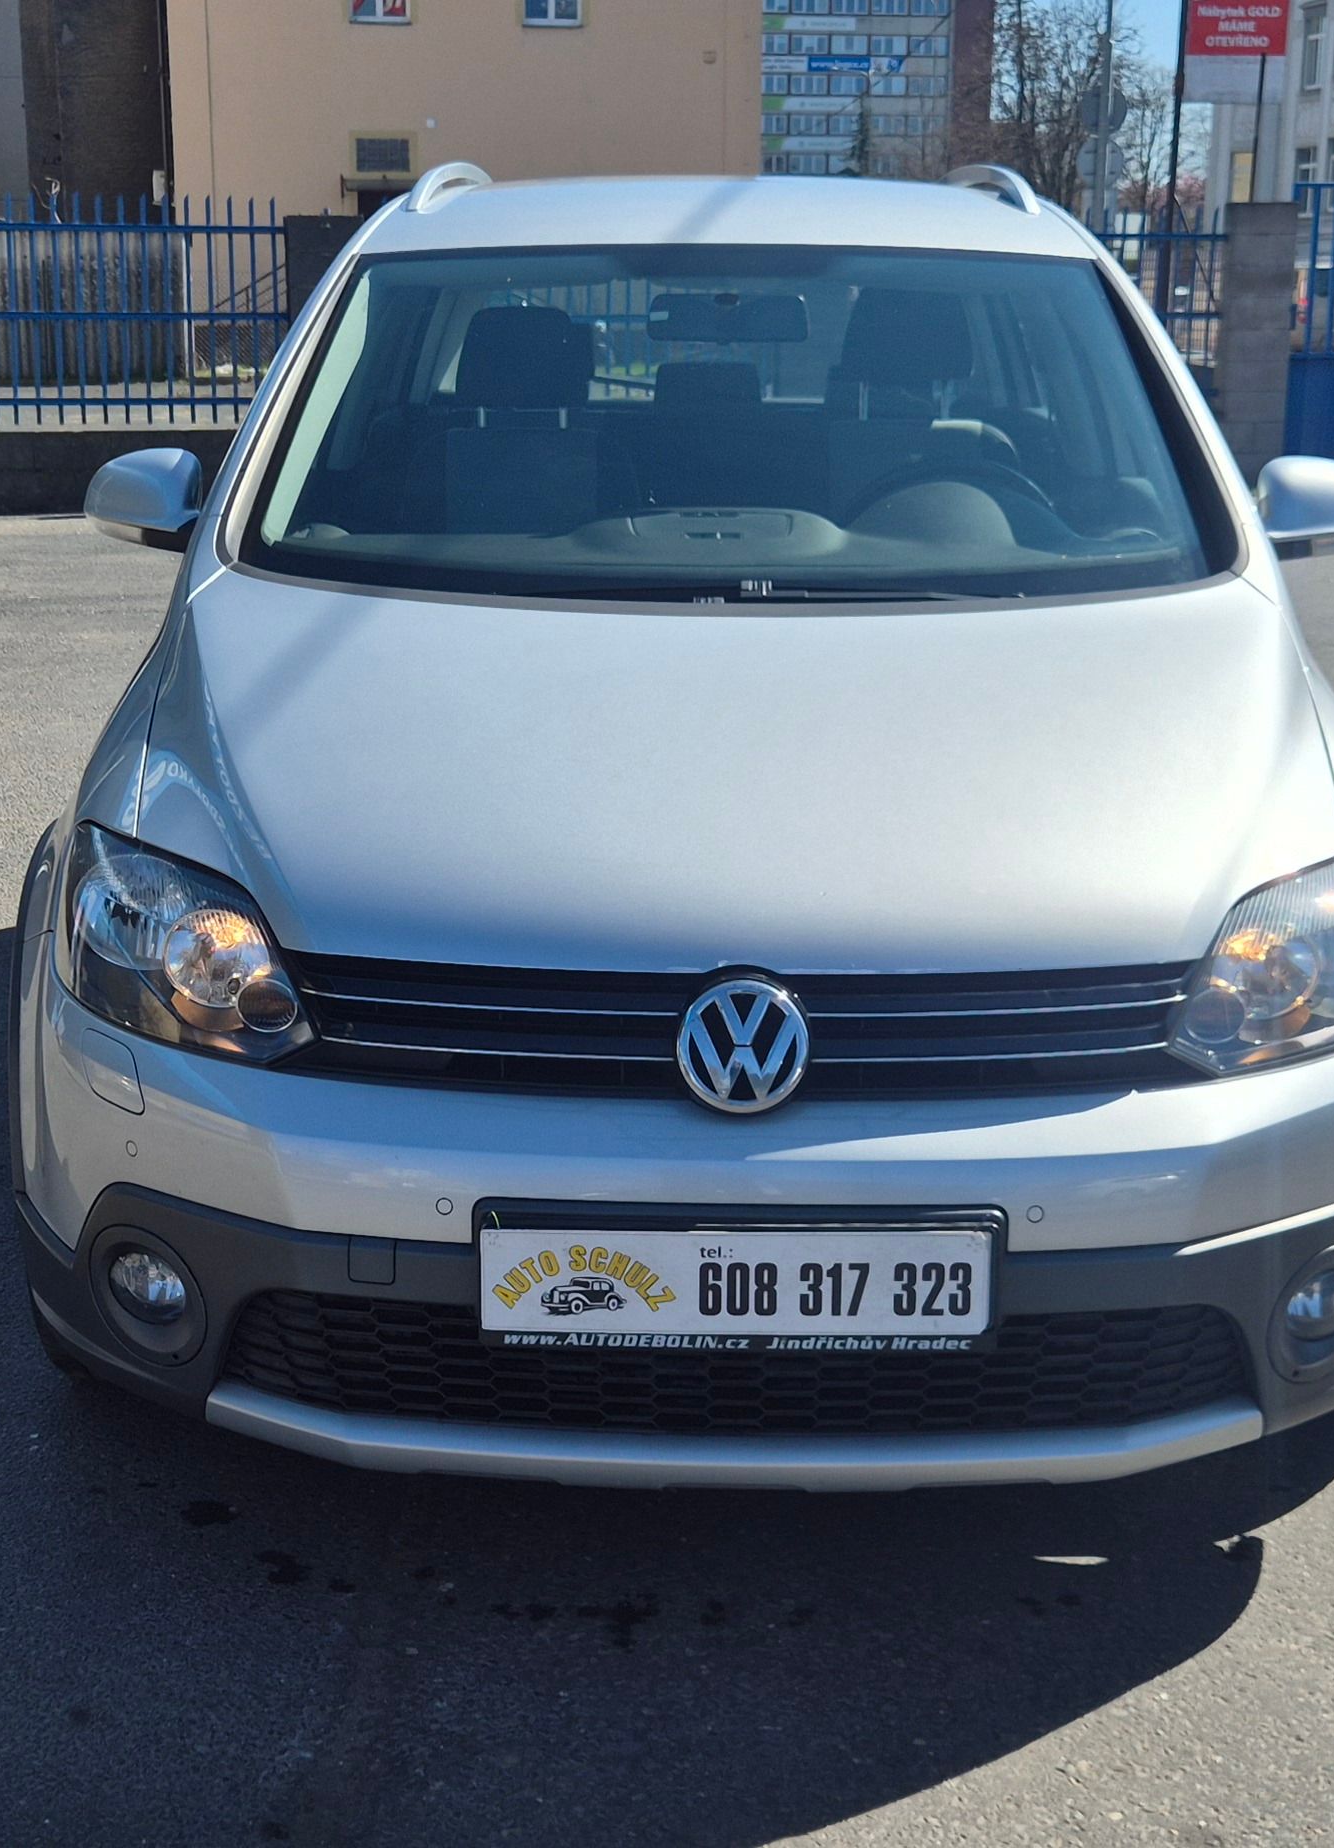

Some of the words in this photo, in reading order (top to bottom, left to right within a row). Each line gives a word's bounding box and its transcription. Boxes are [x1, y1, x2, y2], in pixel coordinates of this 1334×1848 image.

[1247, 6, 1282, 17] GOLD
[679, 980, 808, 1111] VW
[699, 1246, 733, 1258] tel.:
[492, 1250, 560, 1309] AUTO
[569, 1245, 676, 1312] SCHULZ
[698, 1262, 778, 1316] 608
[799, 1262, 870, 1317] 317
[893, 1262, 972, 1317] 323
[503, 1333, 749, 1350] www.AUTODEBOLIN.cz
[766, 1336, 886, 1351] Jindřichův
[891, 1337, 971, 1351] Hradec
